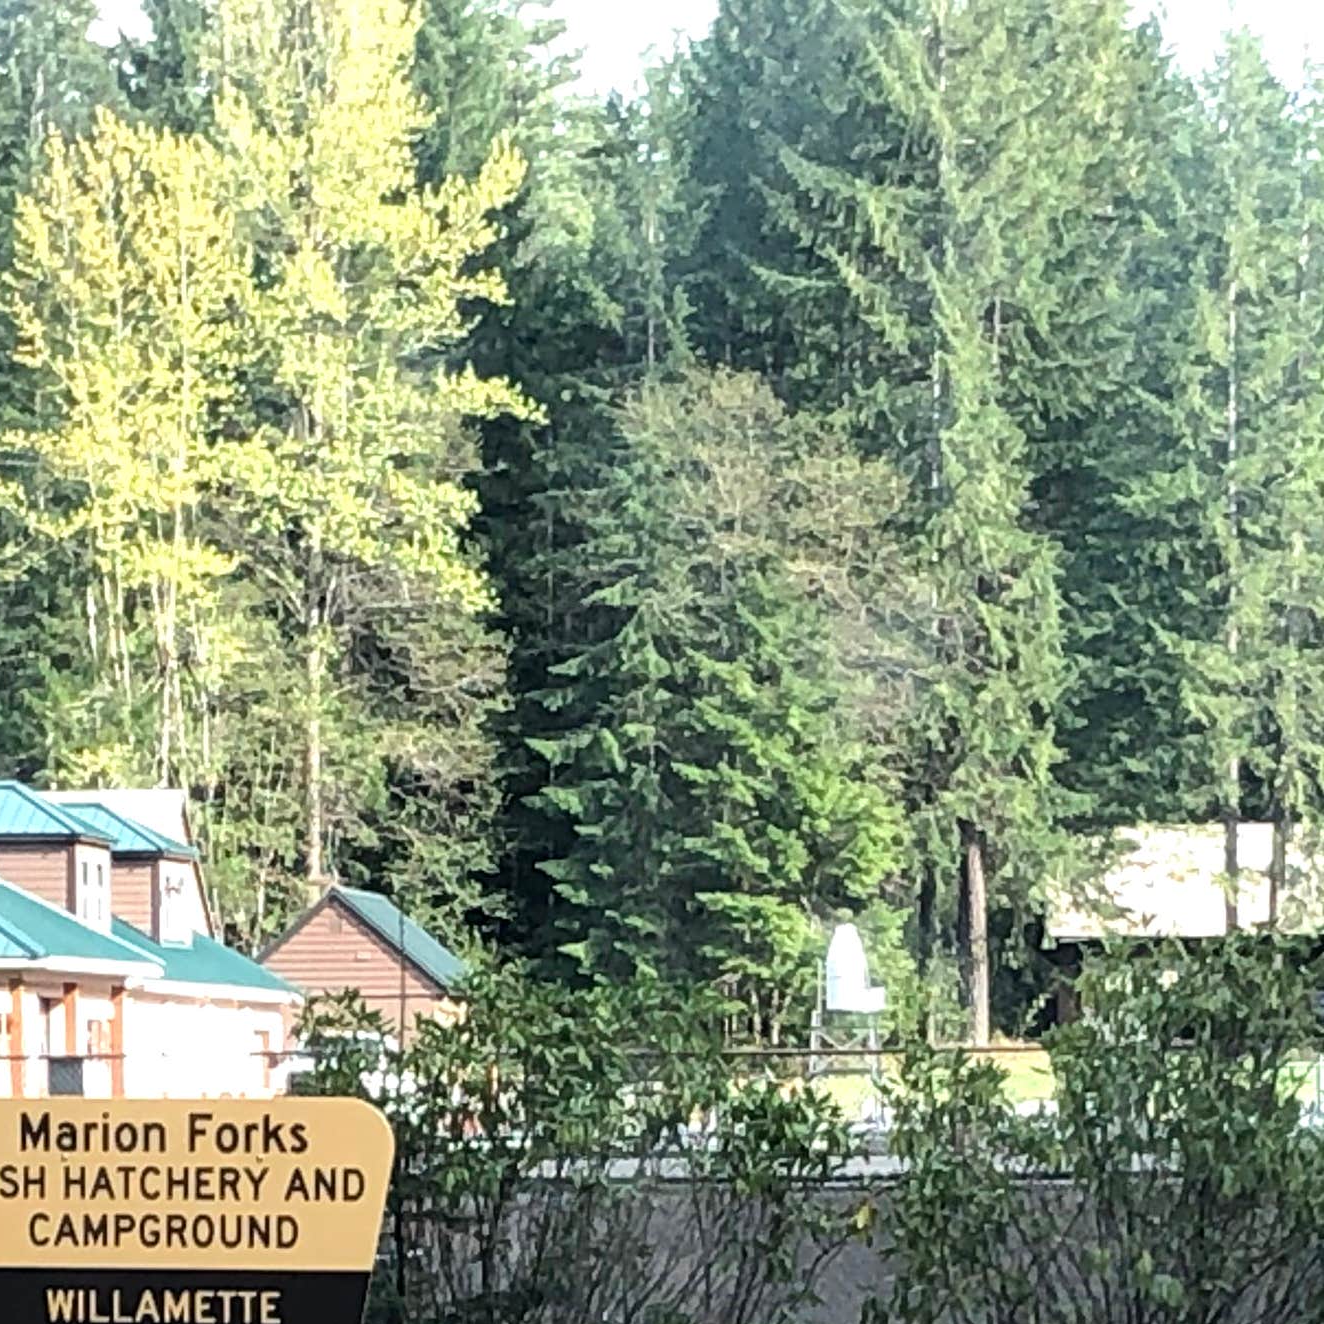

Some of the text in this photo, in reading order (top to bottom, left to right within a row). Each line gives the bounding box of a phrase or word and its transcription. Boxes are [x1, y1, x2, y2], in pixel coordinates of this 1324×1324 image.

[20, 1112, 308, 1154] Marion Forks
[64, 1166, 269, 1201] HATCHERY
[284, 1167, 365, 1202] AND
[29, 1213, 299, 1249] CAMPGROUND
